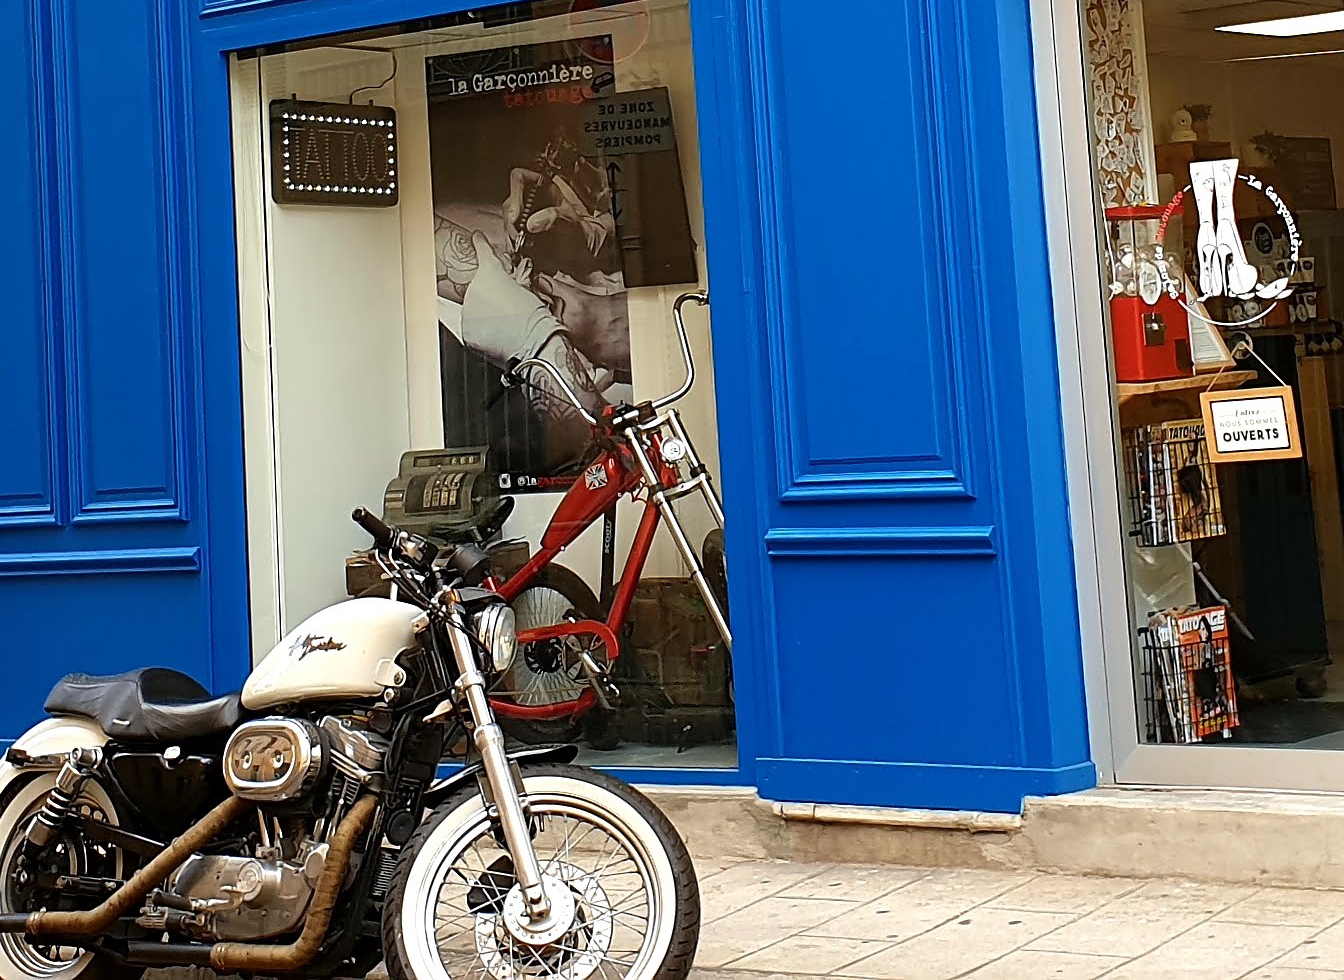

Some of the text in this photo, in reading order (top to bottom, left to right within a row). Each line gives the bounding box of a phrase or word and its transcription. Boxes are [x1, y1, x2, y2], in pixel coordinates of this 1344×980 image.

[448, 63, 594, 96] la Garçonnière
[289, 127, 388, 181] TATTOO
[1265, 186, 1302, 262] Garçonnière
[1222, 428, 1280, 443] OUVERTS
